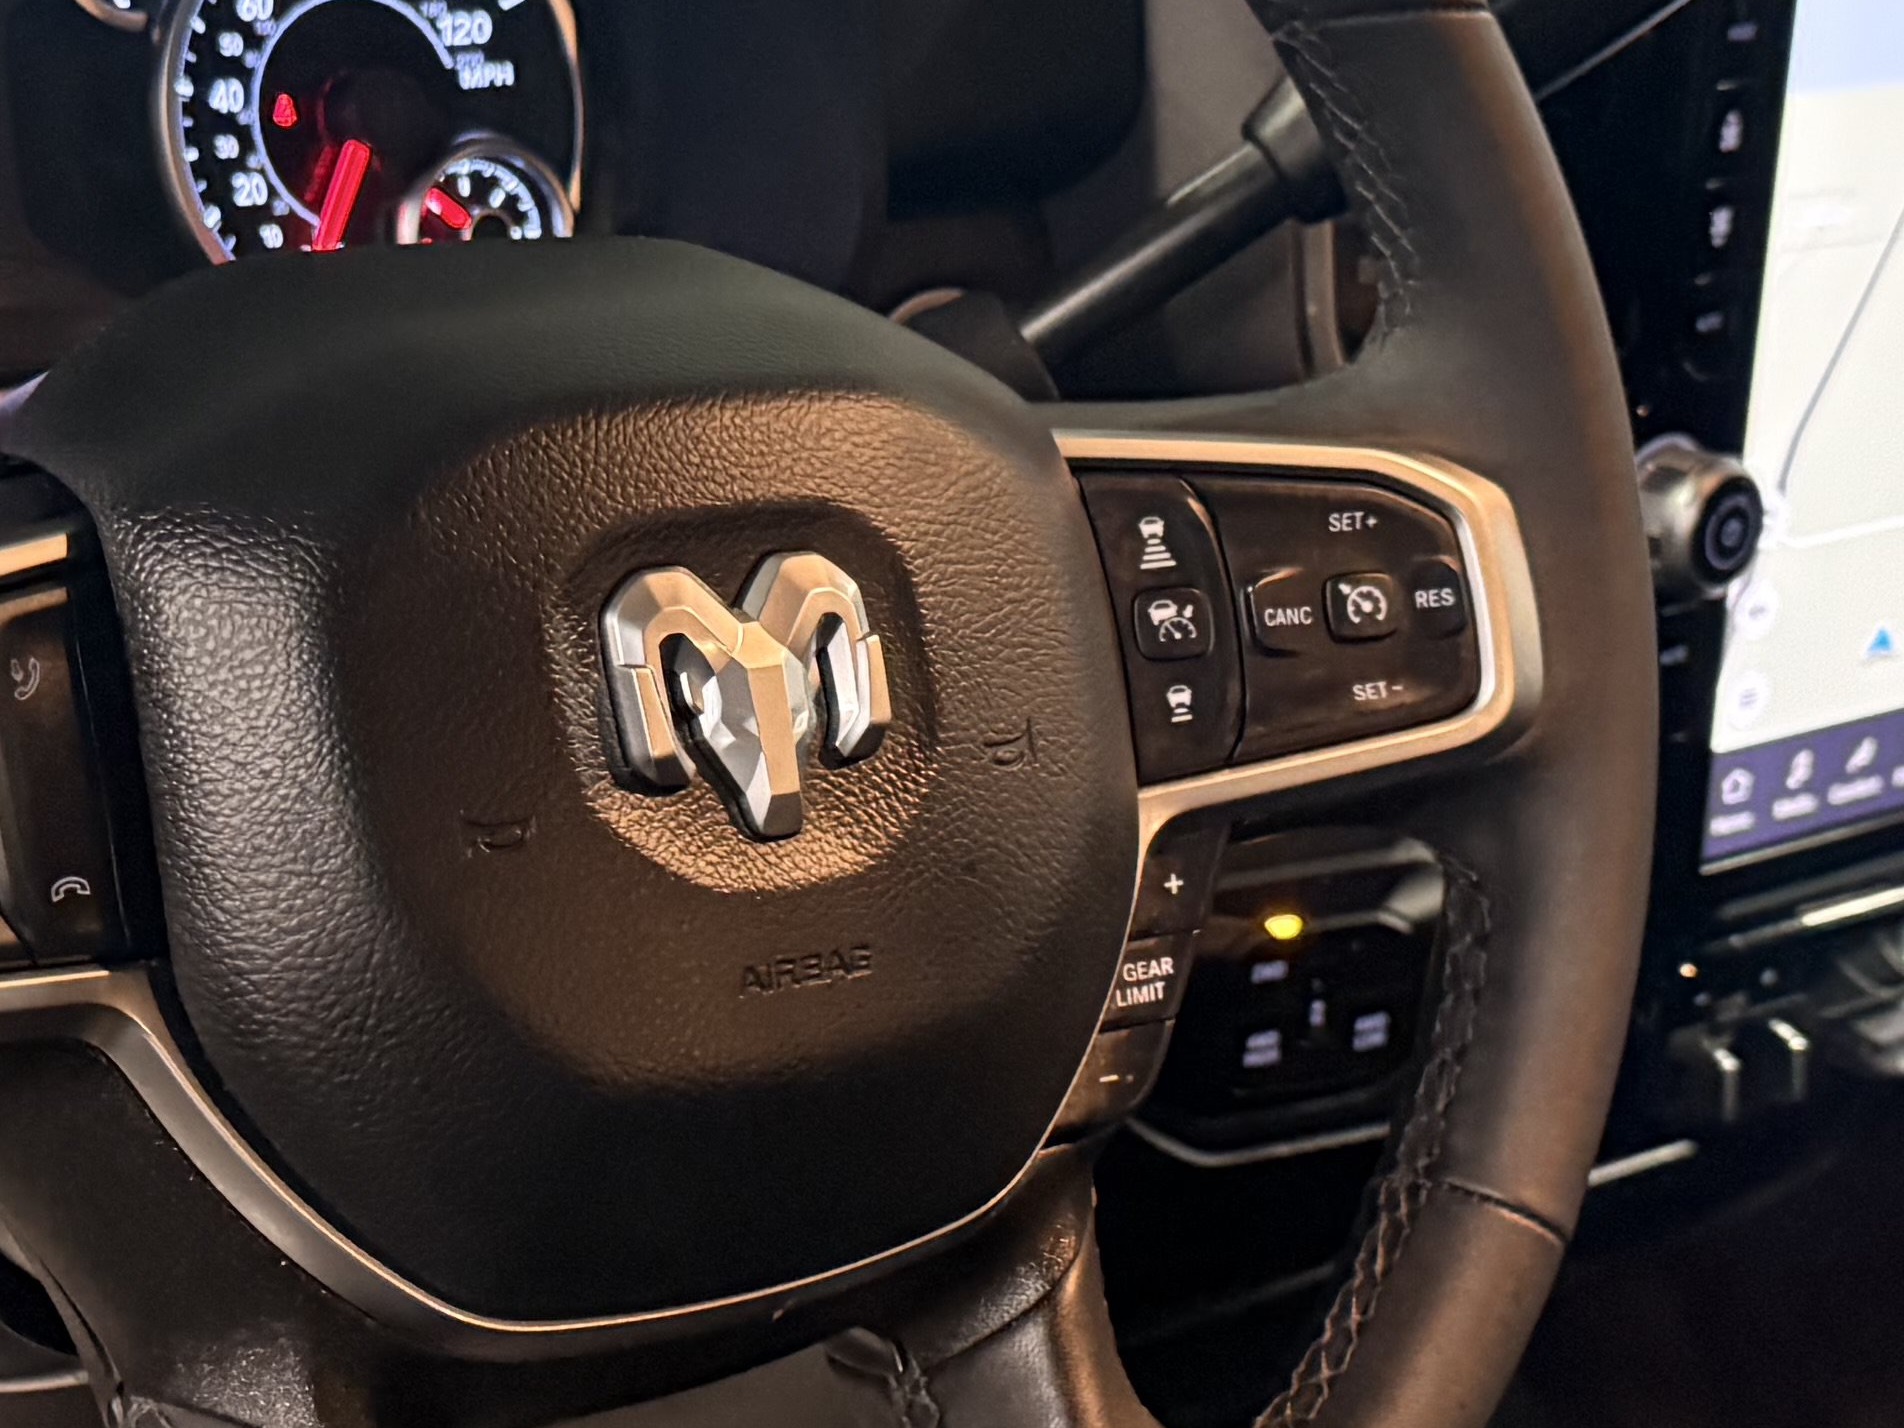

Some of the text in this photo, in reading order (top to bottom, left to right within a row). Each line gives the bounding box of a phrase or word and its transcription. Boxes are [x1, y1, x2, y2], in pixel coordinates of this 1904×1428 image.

[436, 9, 493, 46] 120
[208, 78, 245, 114] 40
[231, 172, 268, 207] 20
[1415, 588, 1455, 609] RES
[1264, 606, 1313, 627] CANC
[739, 944, 873, 999] AIRBAG
[1123, 957, 1174, 982] GEAR
[1116, 981, 1166, 1007] LIMIT
